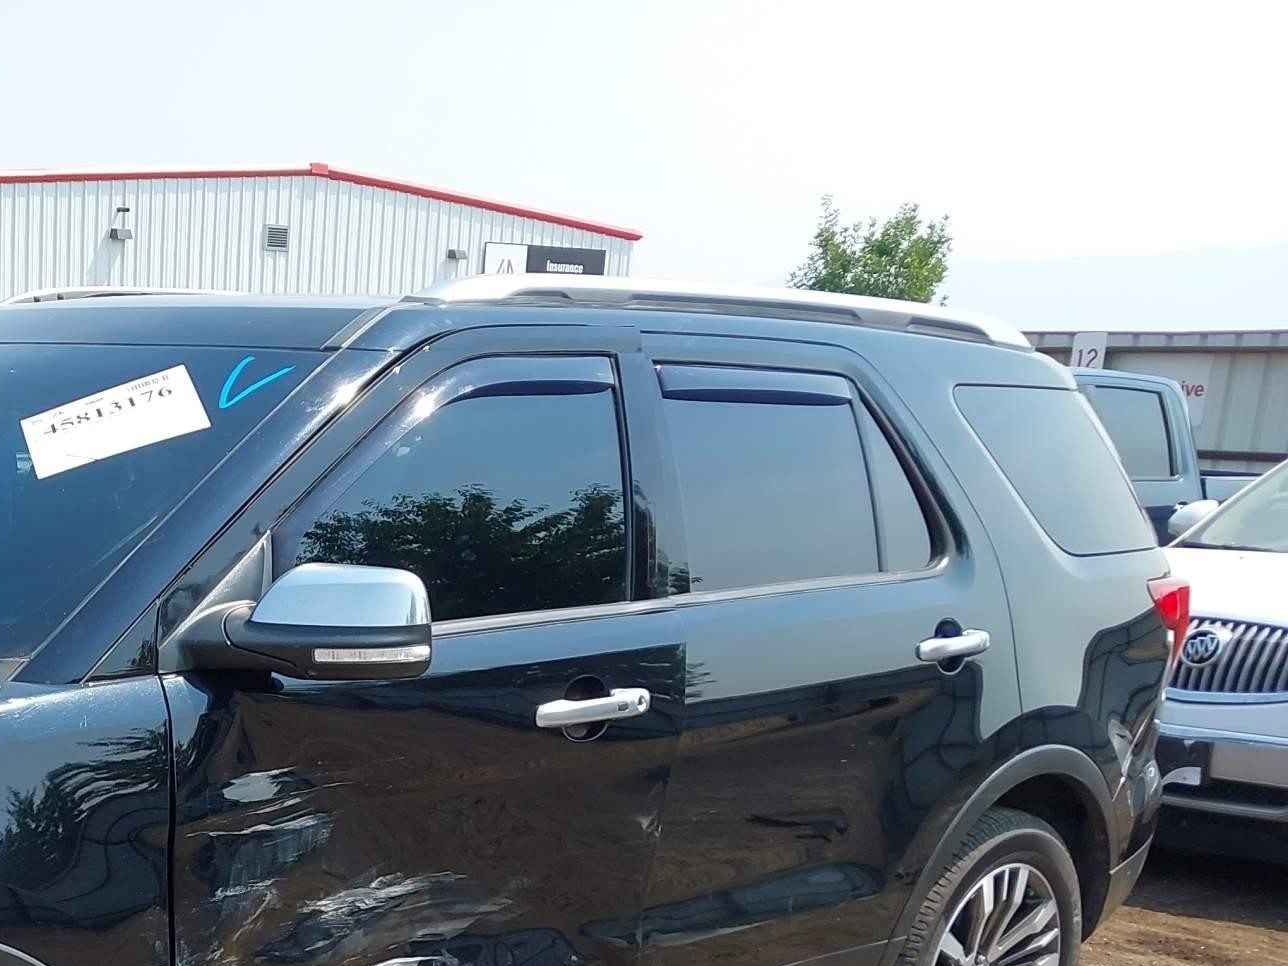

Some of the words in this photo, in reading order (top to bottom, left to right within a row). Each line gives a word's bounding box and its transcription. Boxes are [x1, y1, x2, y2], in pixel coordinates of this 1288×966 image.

[546, 260, 584, 274] Insurance
[1077, 348, 1099, 368] 12
[1181, 379, 1205, 397] ive
[44, 387, 173, 435] 45813176
